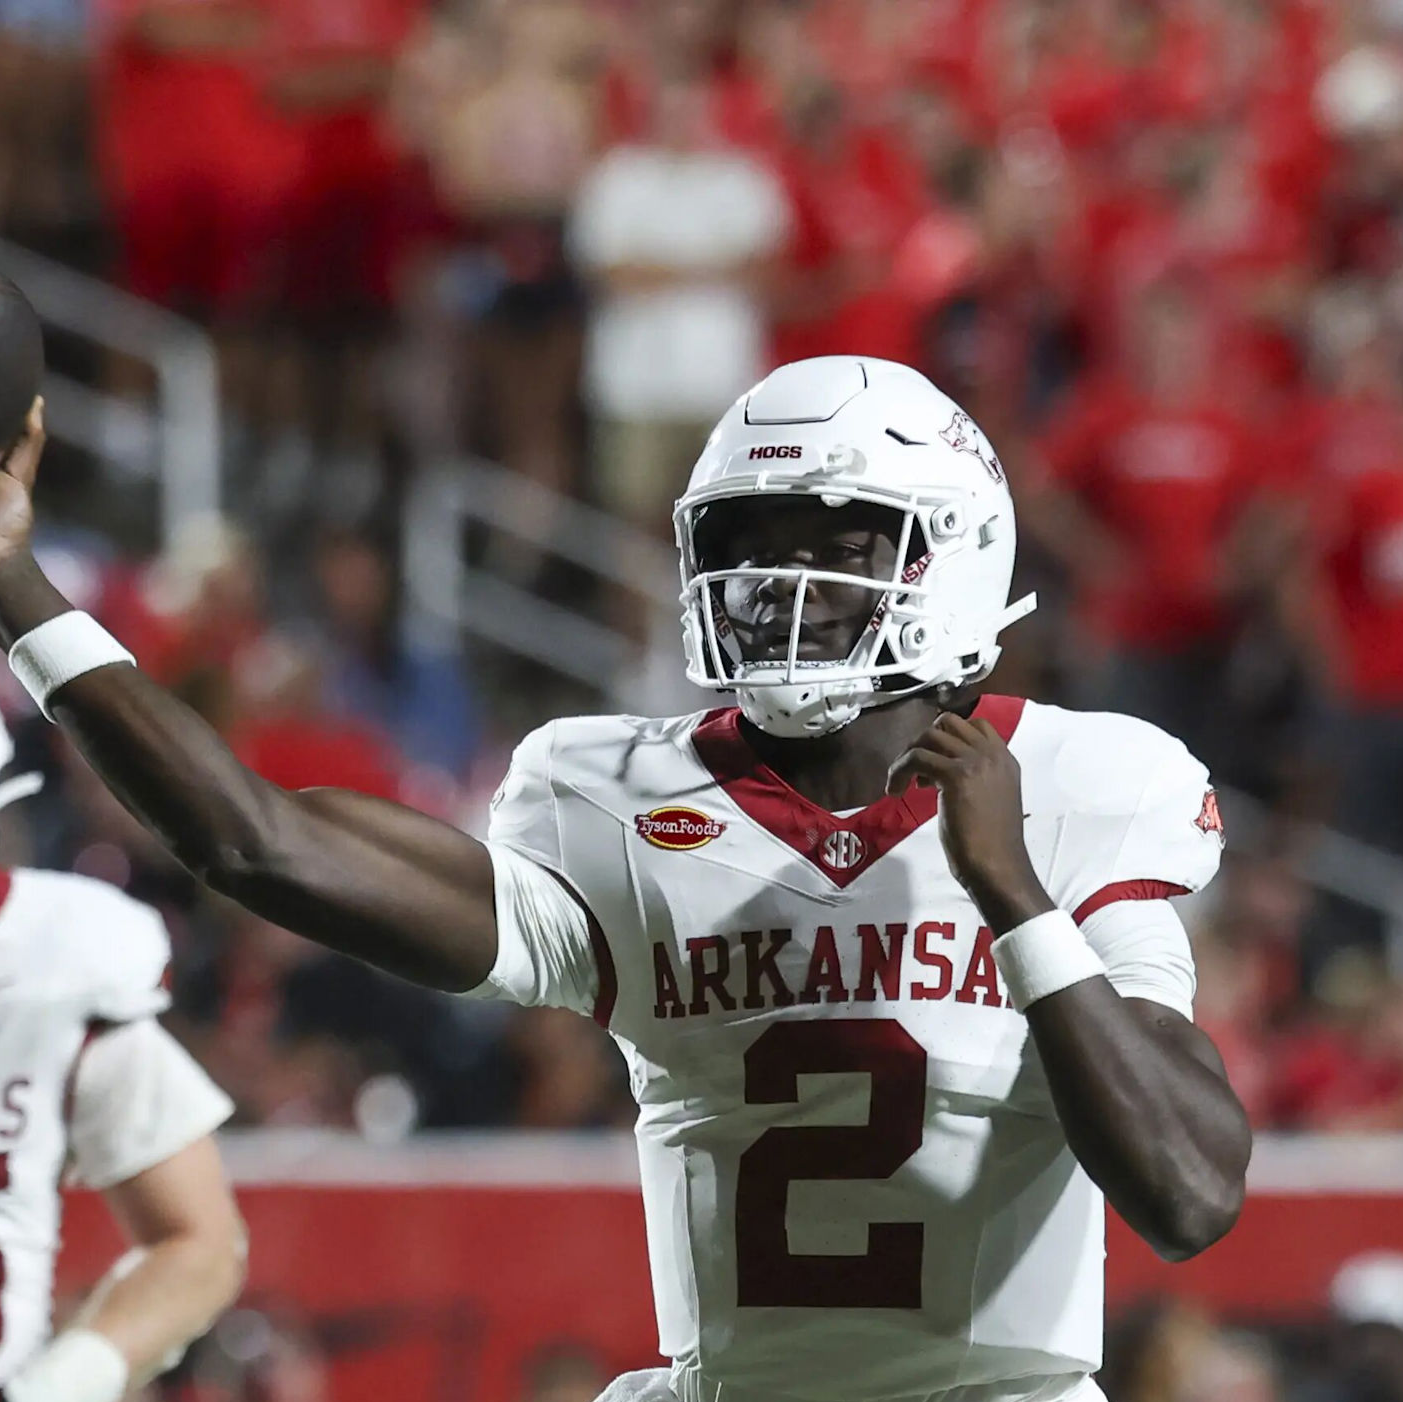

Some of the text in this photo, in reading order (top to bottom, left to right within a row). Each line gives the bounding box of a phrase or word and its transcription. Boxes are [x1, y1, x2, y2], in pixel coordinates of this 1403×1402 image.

[749, 446, 803, 460] HOGS
[823, 829, 863, 869] SEC
[653, 920, 1015, 1019] ARKANSA
[736, 1018, 928, 1309] 2
